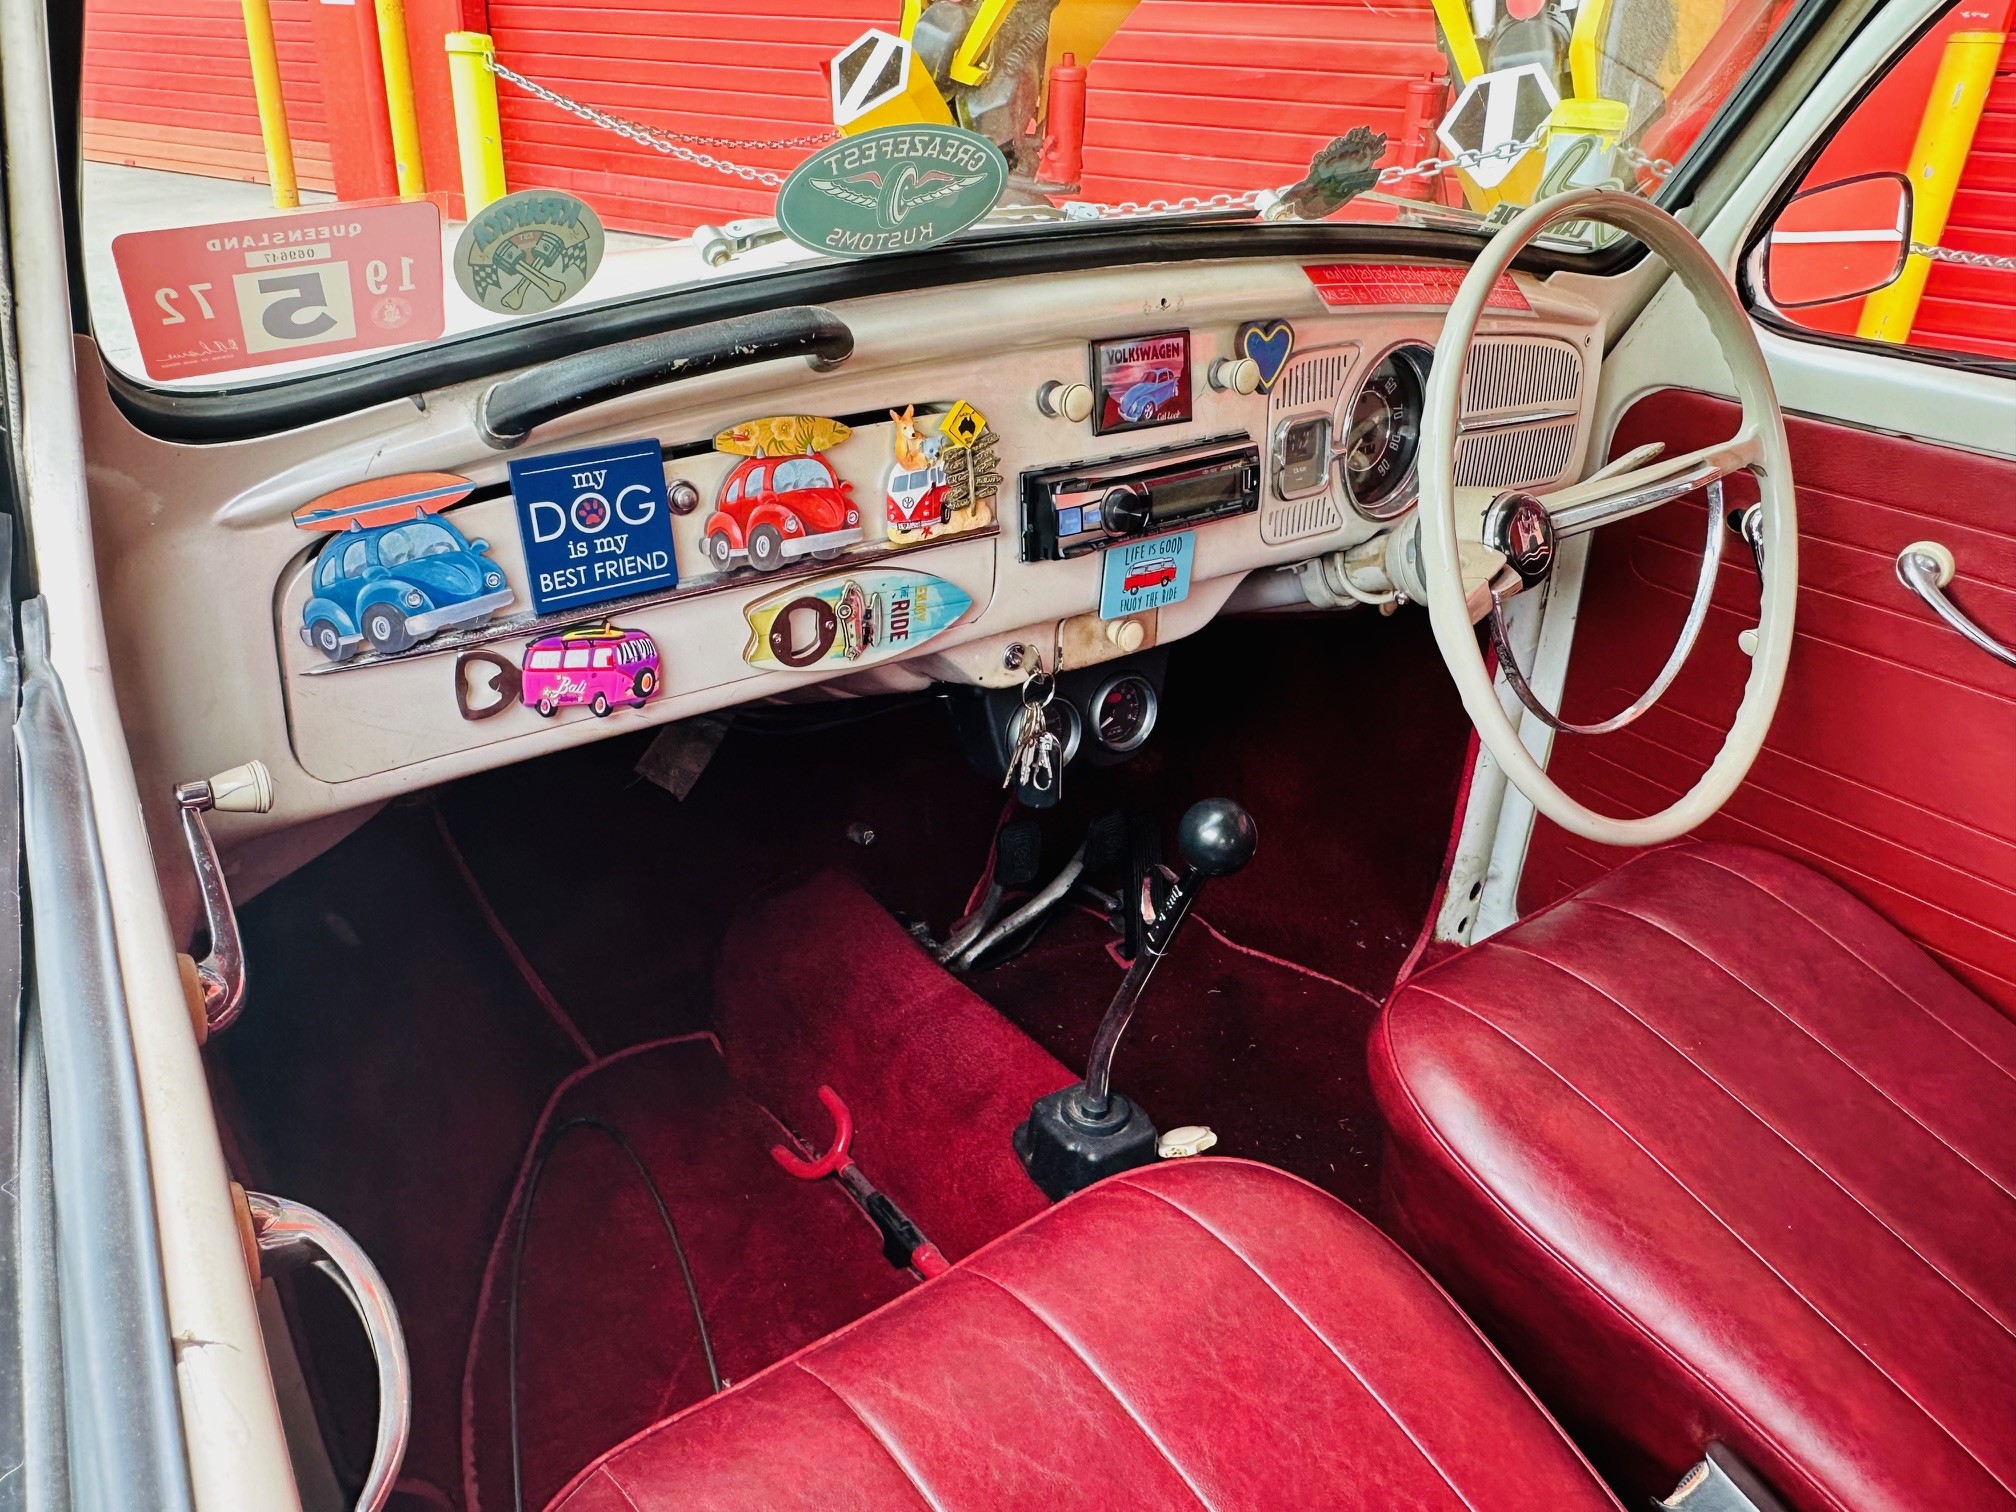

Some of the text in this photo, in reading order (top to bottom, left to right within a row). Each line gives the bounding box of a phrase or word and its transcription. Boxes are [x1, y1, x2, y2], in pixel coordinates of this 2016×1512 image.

[1107, 342, 1180, 364] VOLKSWAGEN
[1389, 434, 1401, 451] 80
[571, 469, 608, 490] my
[1377, 458, 1390, 477] 90
[529, 484, 656, 543] DOG
[568, 533, 629, 559] is my
[1124, 536, 1183, 566] LIFE IS GOOD
[539, 550, 669, 593] BEST FRIEND
[1120, 586, 1178, 612] ENJOY THE RIDE
[889, 598, 911, 643] RIDE
[549, 676, 588, 699] Bali
